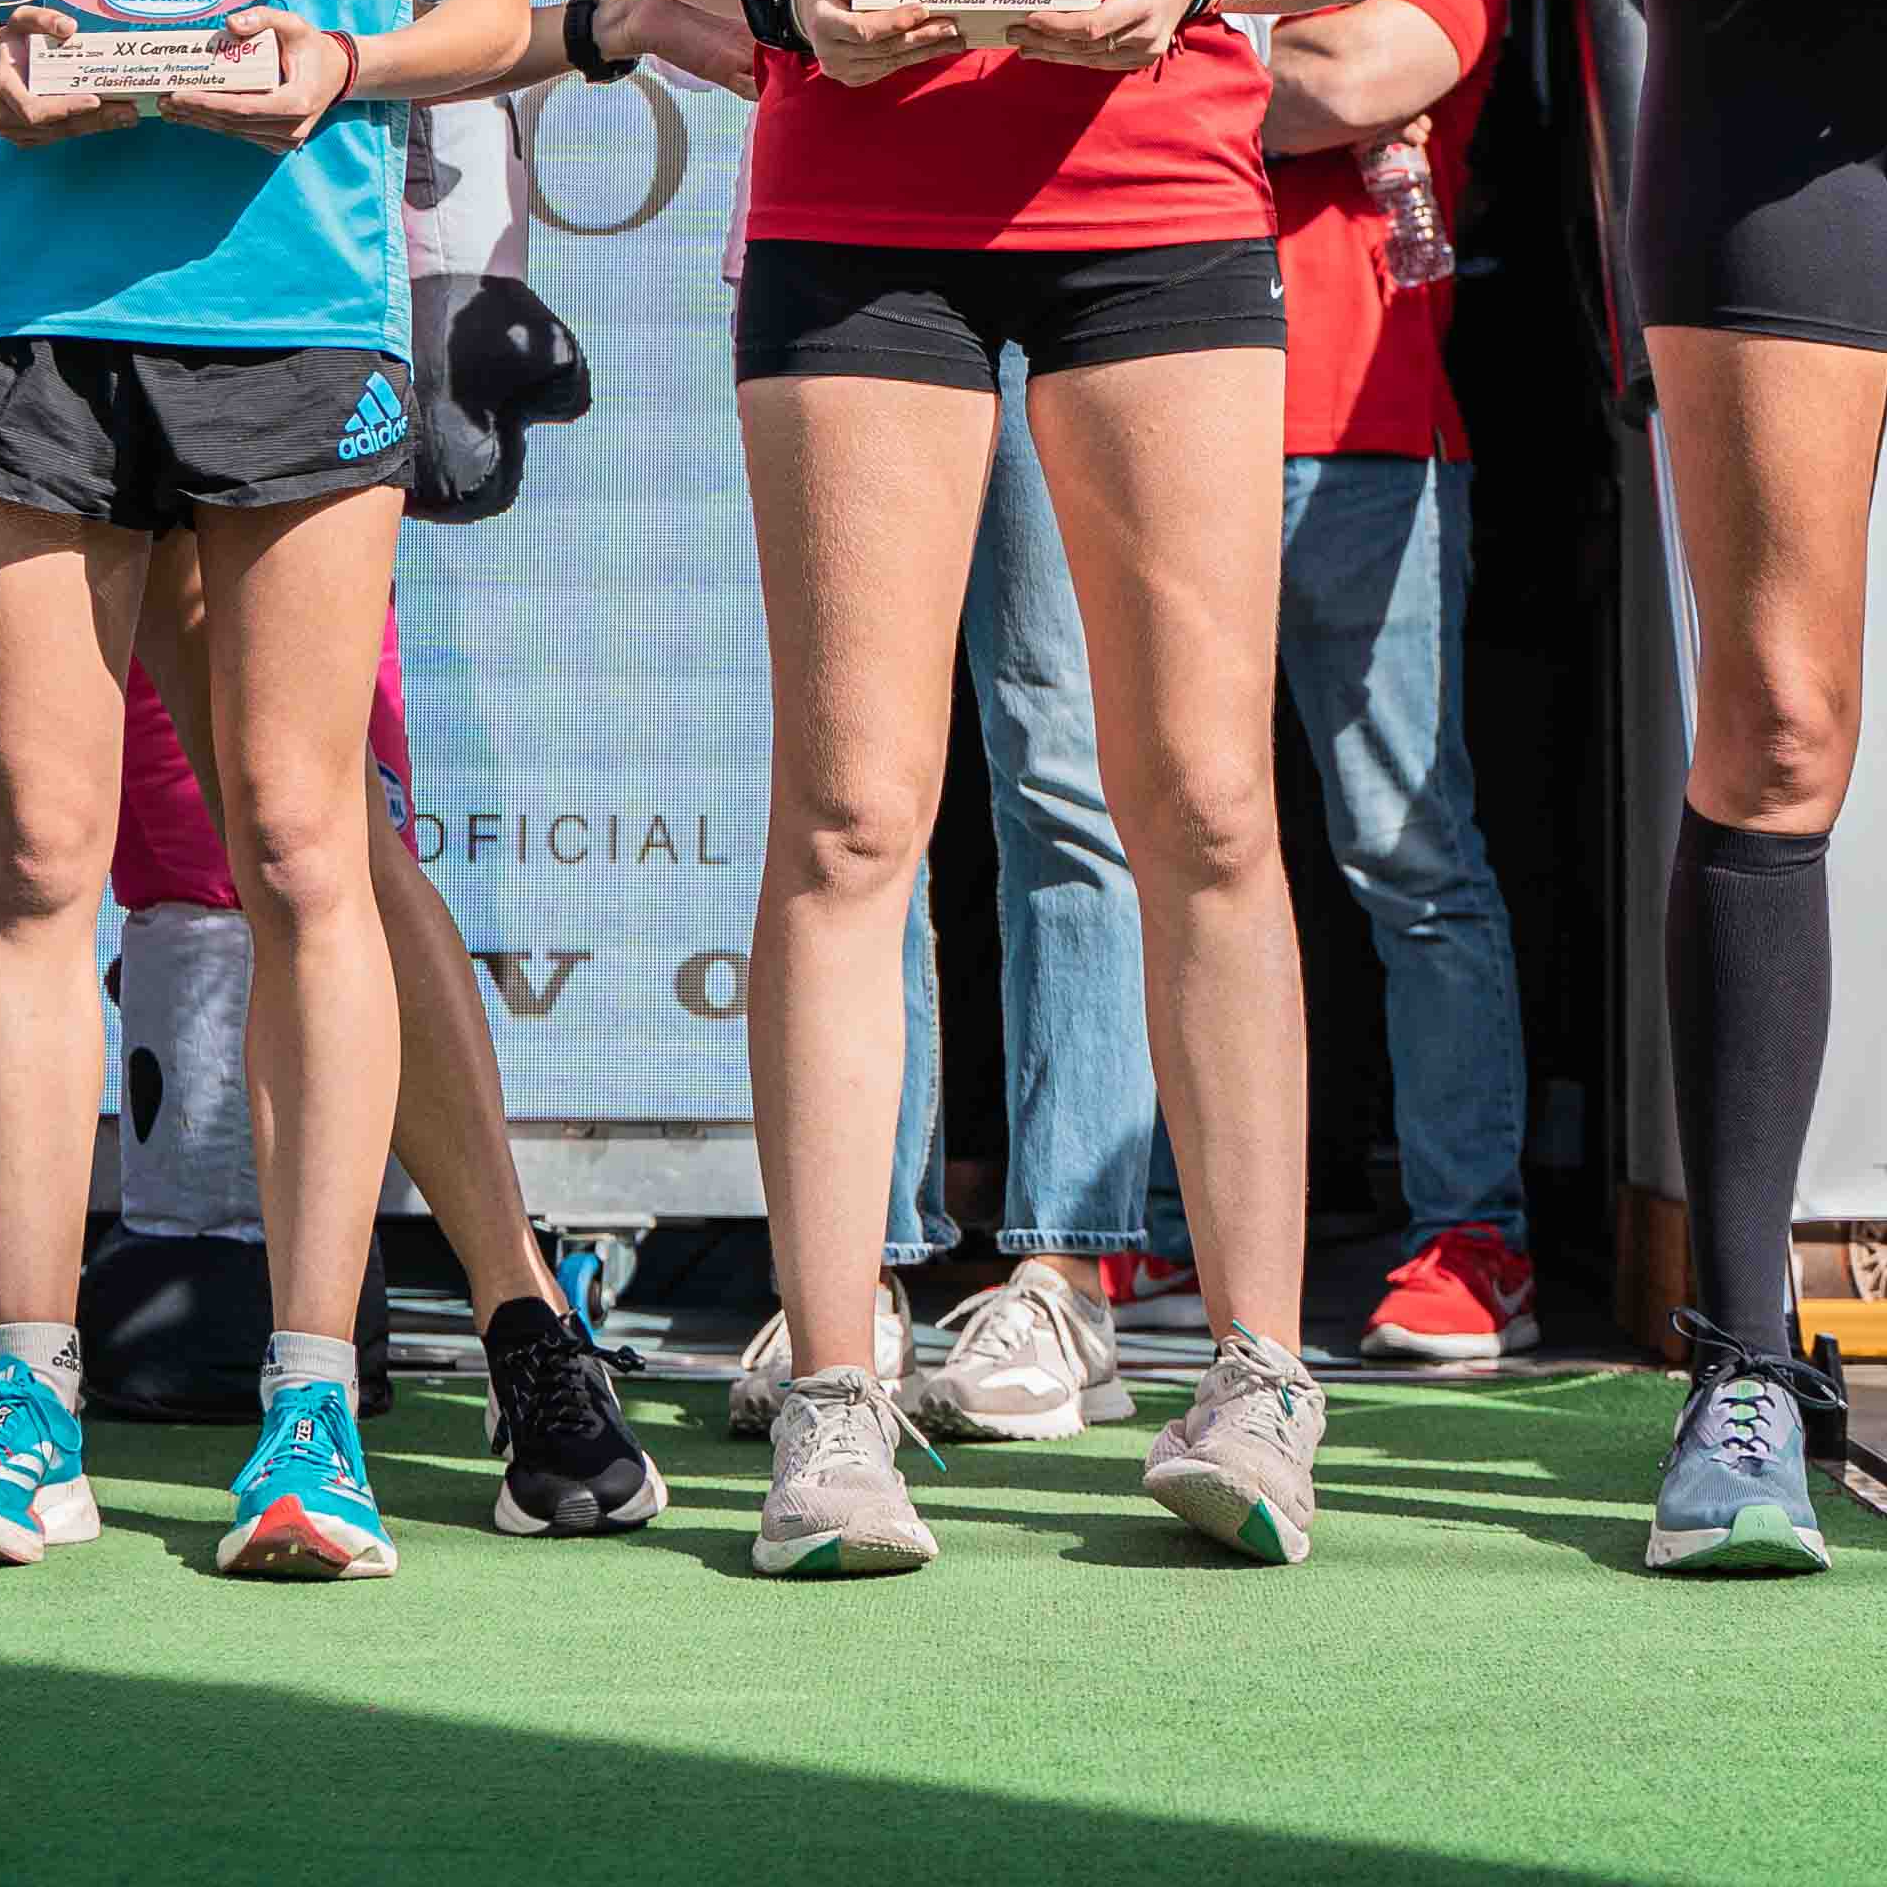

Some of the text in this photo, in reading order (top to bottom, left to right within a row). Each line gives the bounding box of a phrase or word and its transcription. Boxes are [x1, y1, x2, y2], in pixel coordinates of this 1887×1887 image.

[113, 38, 263, 62] XX Carrera de la Mujer
[94, 74, 160, 87] Clasificada
[167, 74, 226, 86] Absoluta
[338, 414, 409, 460] adidas
